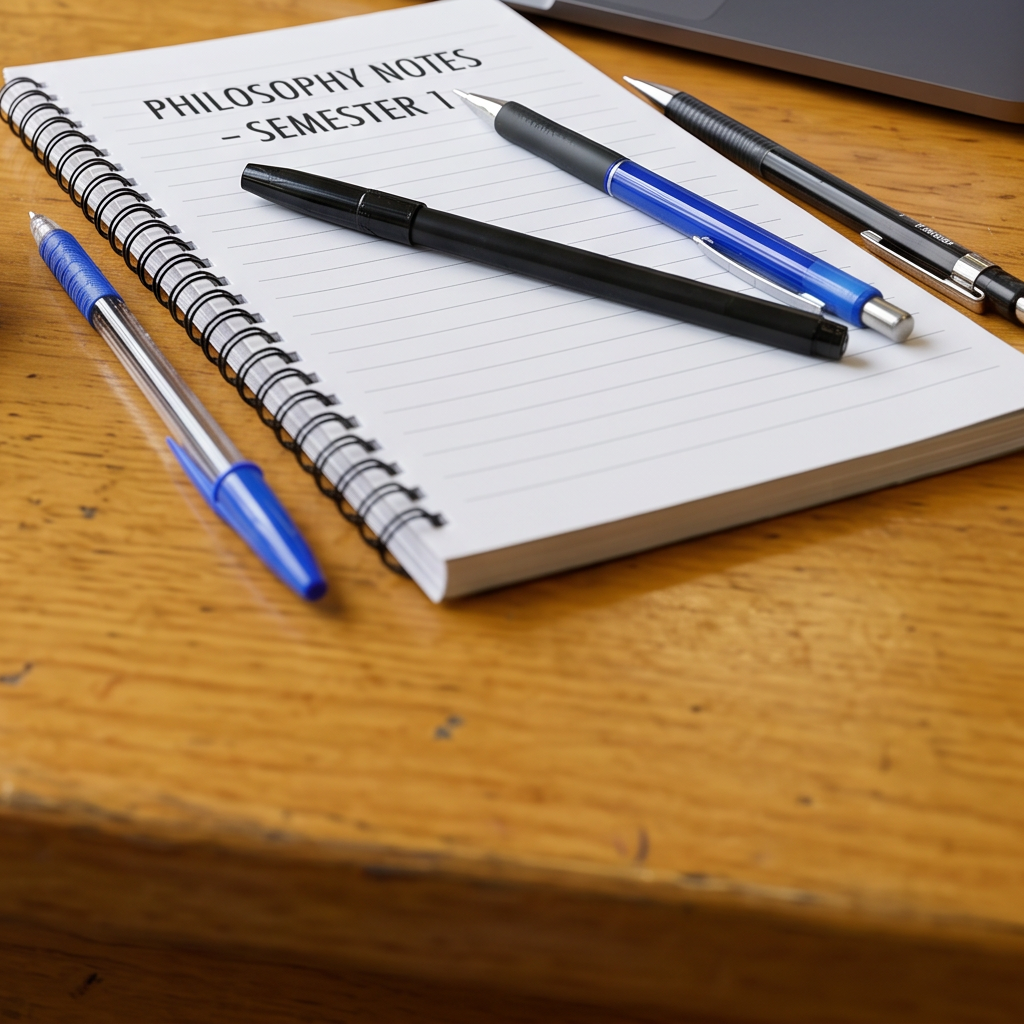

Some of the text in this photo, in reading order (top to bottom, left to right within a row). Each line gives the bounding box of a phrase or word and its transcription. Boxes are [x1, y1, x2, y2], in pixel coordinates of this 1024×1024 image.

[143, 47, 483, 120] PHILOSOPHY NOTES
[246, 95, 429, 142] SEMESTER
